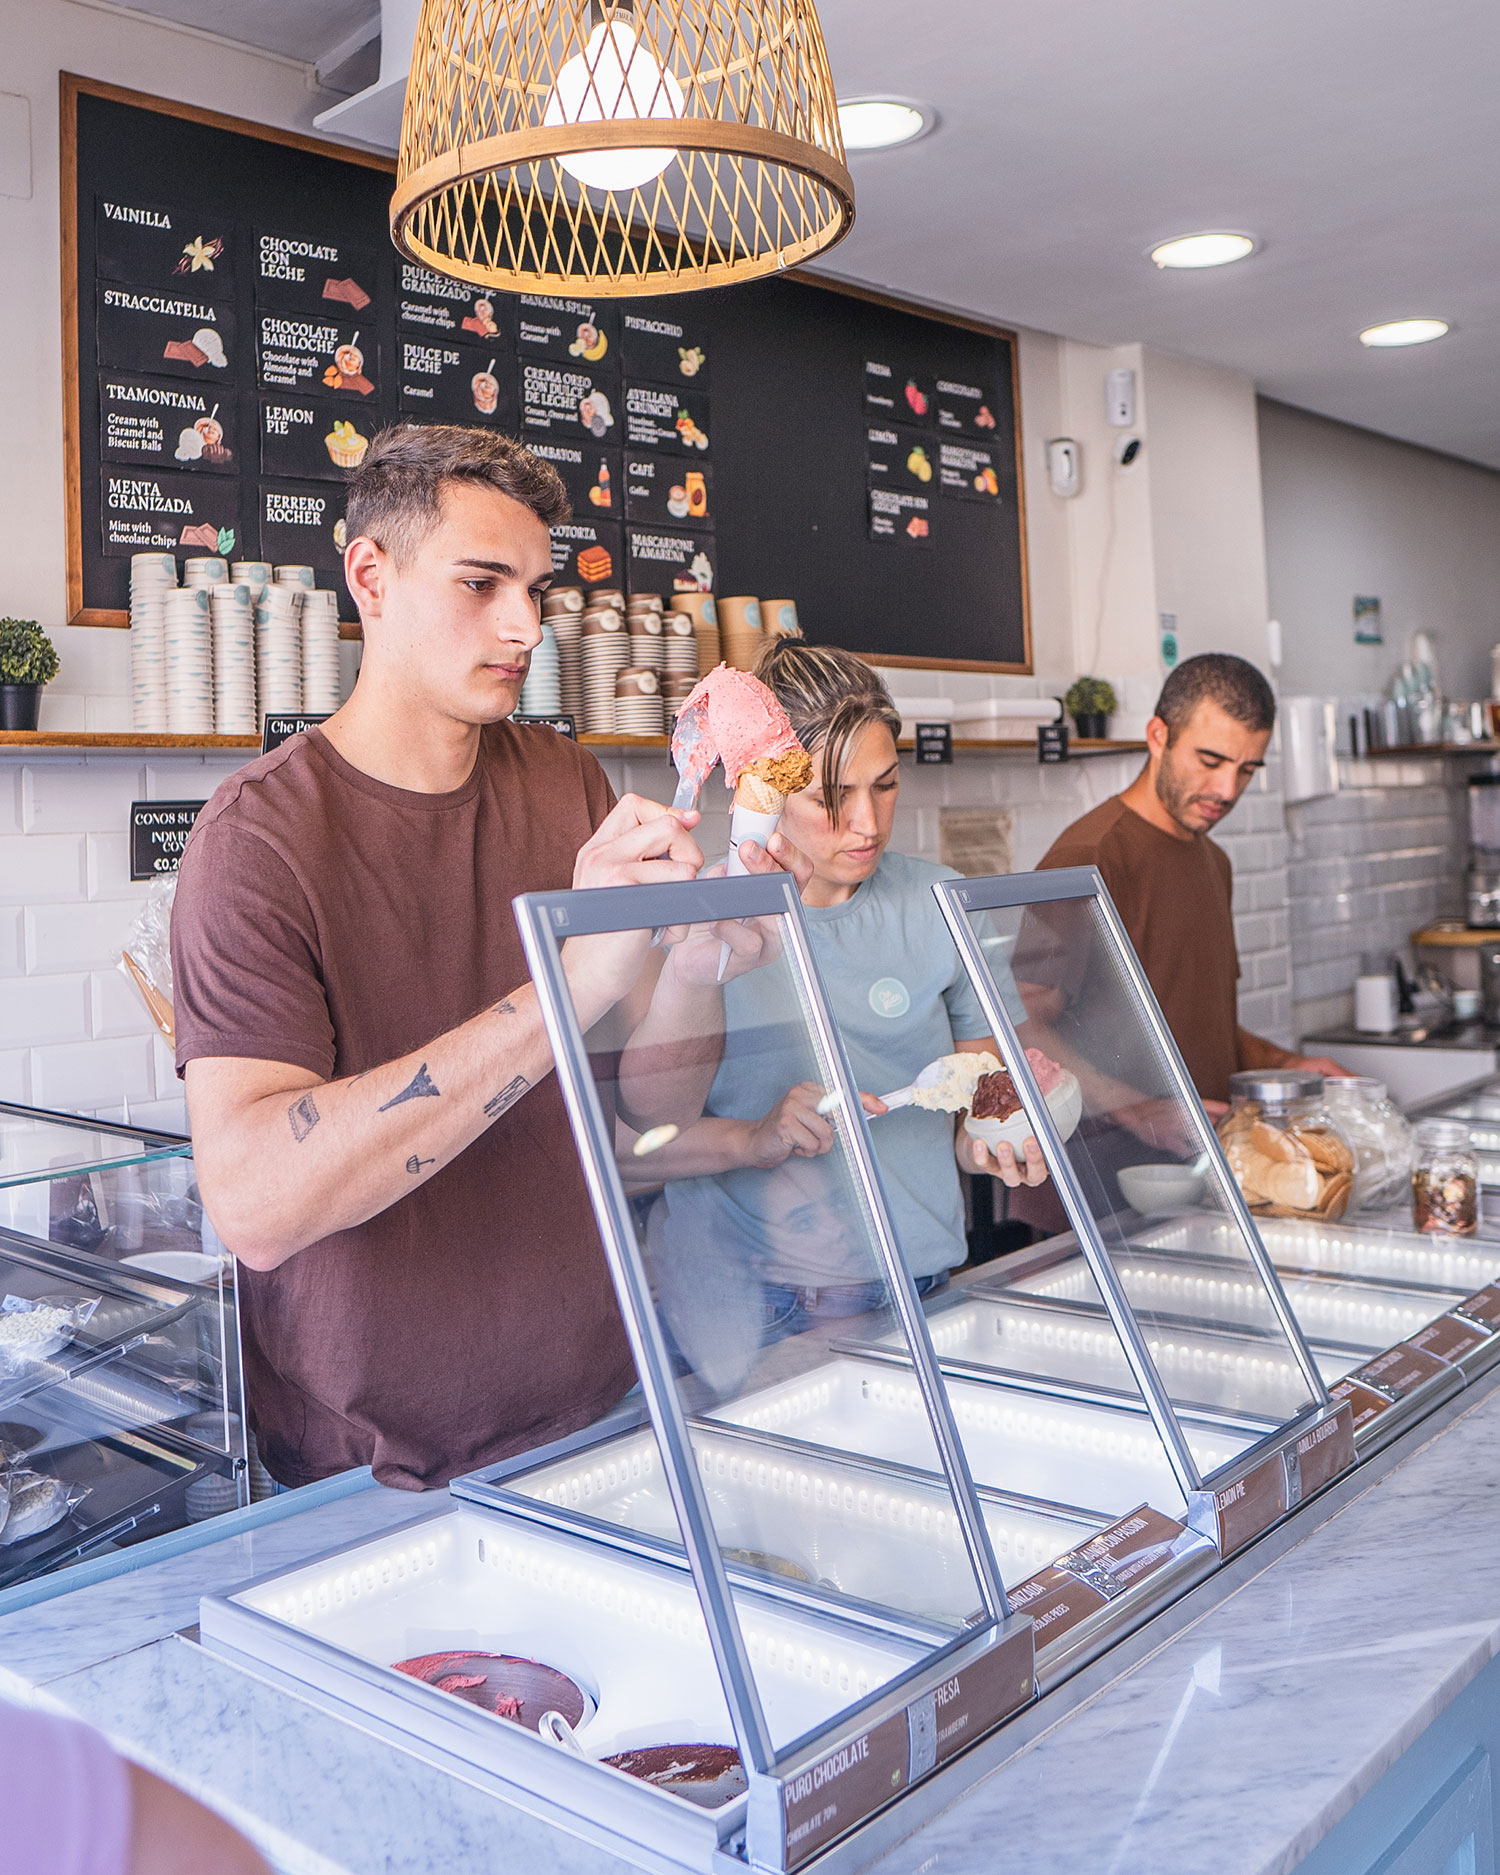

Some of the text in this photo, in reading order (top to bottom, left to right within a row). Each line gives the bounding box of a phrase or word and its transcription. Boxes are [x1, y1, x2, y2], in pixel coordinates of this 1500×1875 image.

[104, 202, 172, 230] VAINILLA
[260, 236, 338, 262] CHOCOLATE
[260, 250, 290, 266] CON
[260, 264, 305, 282] LECHE
[402, 278, 471, 302] GRANIZADO
[104, 290, 216, 322] STRACCIATELLA
[565, 300, 592, 317] SPLIT
[262, 318, 338, 342] CHOCOLATE
[262, 329, 335, 354] BARILOCHE
[262, 350, 318, 368] Chocolate with
[404, 344, 460, 366] DULCE DE
[263, 362, 312, 377] Almonds and
[404, 358, 442, 375] LECHE
[524, 366, 562, 384] CREMA
[264, 372, 296, 386] Caramel
[524, 378, 585, 399] CON DULCE
[106, 384, 206, 412] TRAMONTANA
[524, 390, 577, 410] DE LECHE
[108, 413, 158, 429] Cream with
[266, 406, 314, 424] LEMON
[108, 424, 164, 440] Caramel and
[266, 420, 289, 436] PIE
[108, 436, 162, 452] Biscuit Balls
[628, 462, 655, 478] CAFÉ
[108, 478, 162, 497] MENTA
[108, 494, 194, 514] GRANIZADA
[266, 494, 326, 512] FERRERO
[266, 509, 322, 526] ROCHER
[109, 520, 152, 534] Mint with
[109, 532, 177, 548] chocolate Chips
[271, 720, 294, 734] Che
[135, 812, 176, 826] CONOS
[1217, 1480, 1246, 1512] LEMON PIE
[784, 1734, 870, 1808] PURO CHOCOLATE
[786, 1813, 822, 1848] CHOCOLATE
